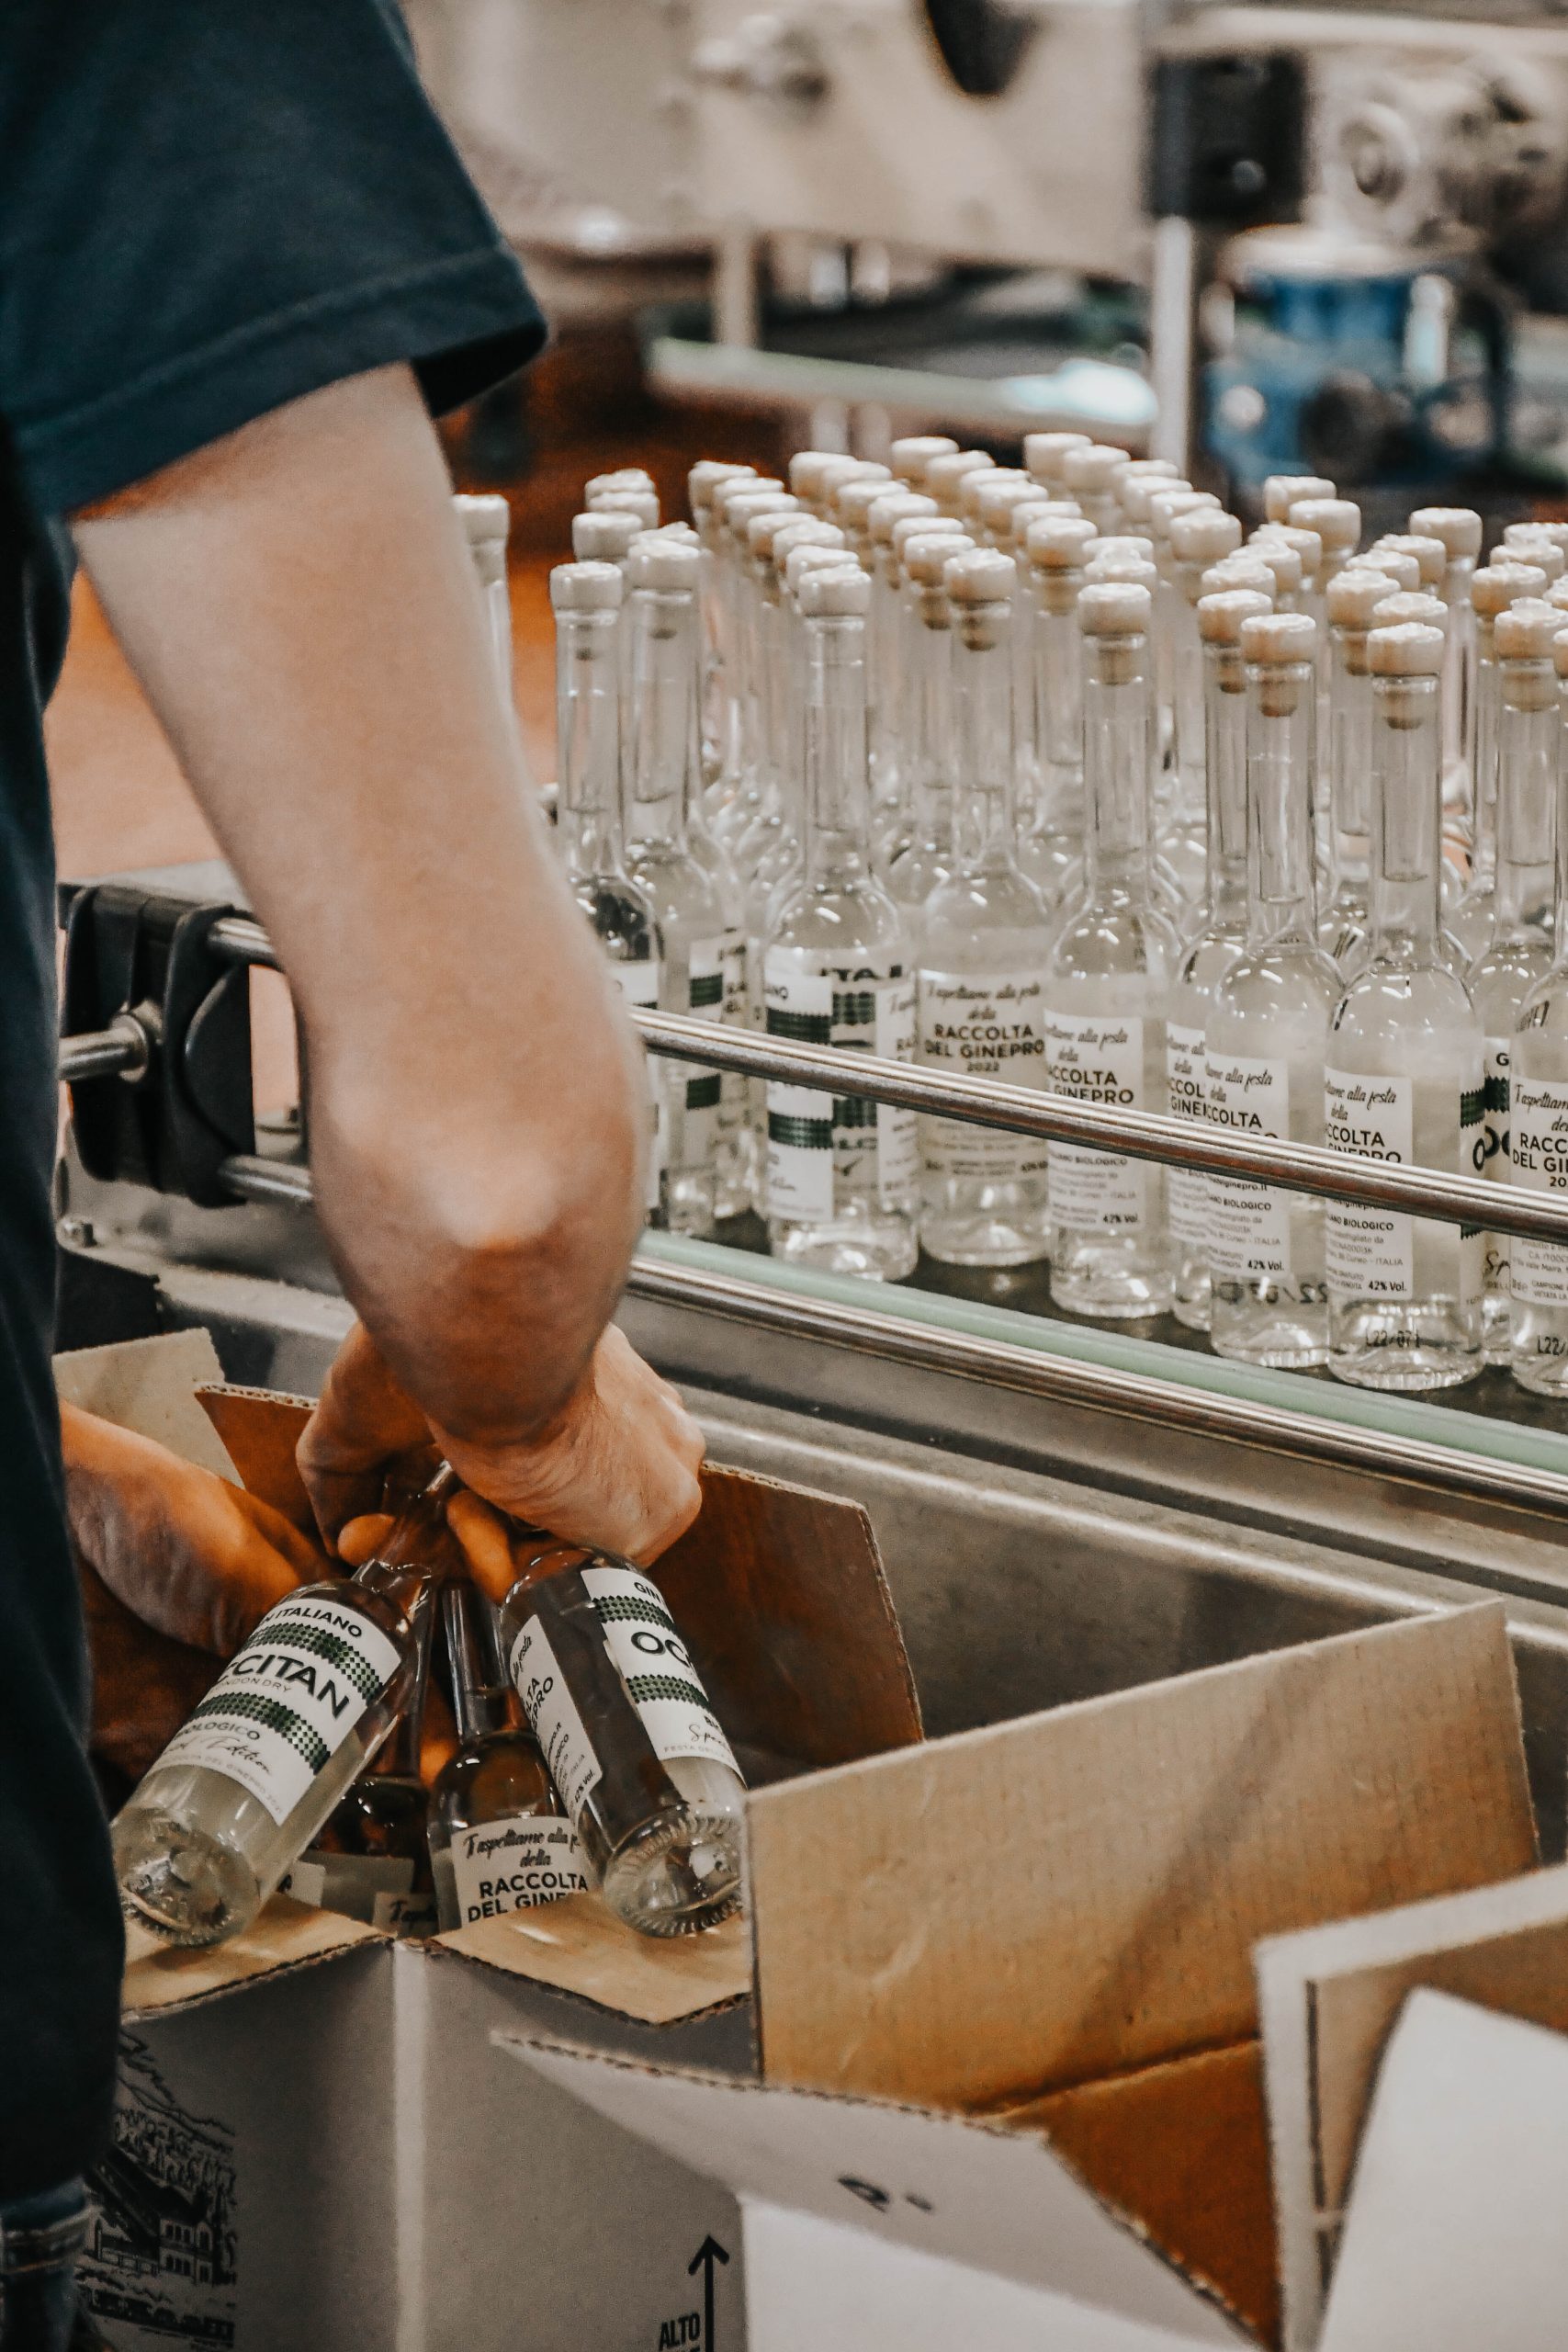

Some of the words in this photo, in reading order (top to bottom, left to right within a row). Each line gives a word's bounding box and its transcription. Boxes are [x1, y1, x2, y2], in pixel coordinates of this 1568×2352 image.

[934, 1023, 1033, 1041] RACCOLTA
[960, 1039, 1045, 1058] GINEPRO
[1347, 1084, 1366, 1102] alla
[1366, 1086, 1397, 1111] festa
[1513, 1149, 1538, 1170] DEL
[1223, 1197, 1272, 1212] BIOLOGICO
[1343, 1217, 1394, 1231] BIOLOGICO
[1247, 1260, 1266, 1271] 42%
[1375, 1257, 1404, 1266] ITALIA
[1369, 1281, 1388, 1291] 42%
[276, 1608, 362, 1638] ITALIANO
[520, 1849, 551, 1868] della
[479, 1871, 589, 1900] RACCOLTA
[468, 1898, 509, 1923] DEL
[658, 2312, 701, 2350] ALTO
